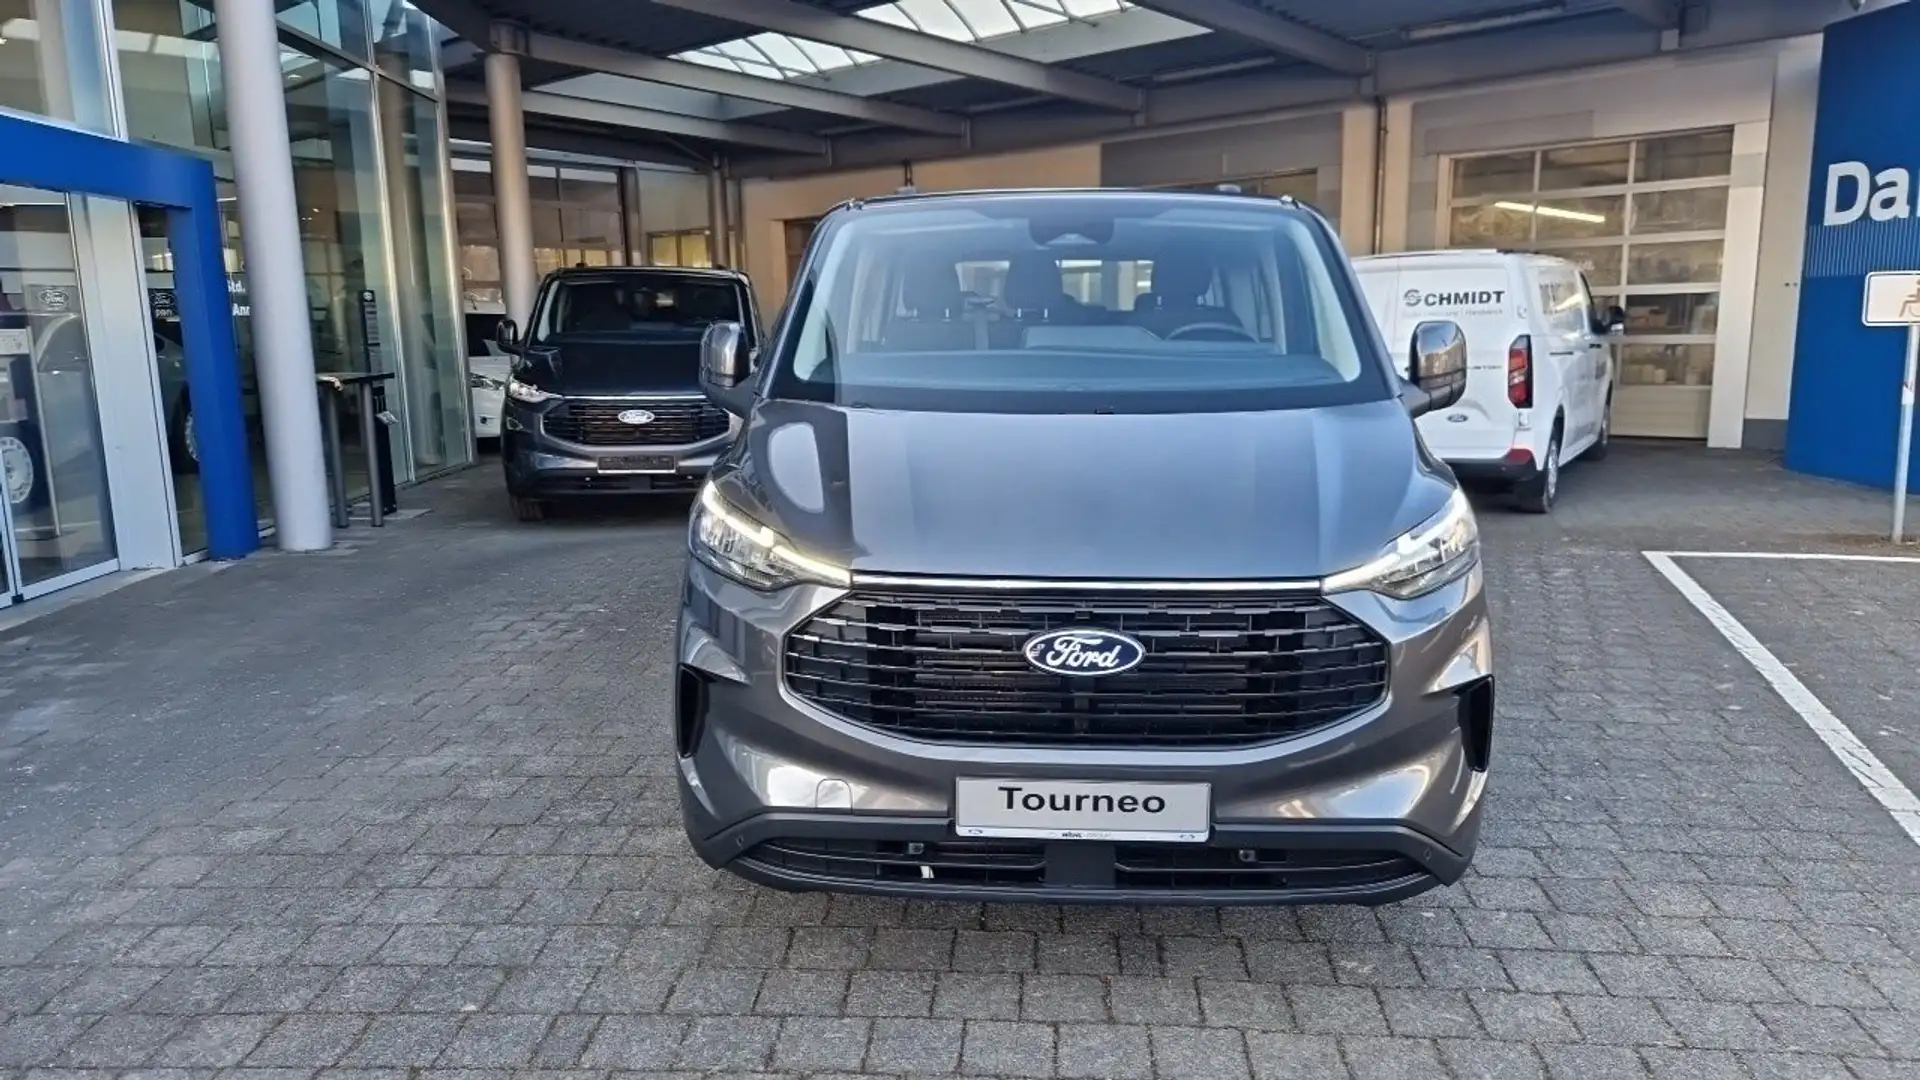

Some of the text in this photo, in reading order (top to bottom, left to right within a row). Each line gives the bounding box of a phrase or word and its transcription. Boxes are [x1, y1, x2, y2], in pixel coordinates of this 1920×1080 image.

[1823, 161, 1920, 226] Da
[1404, 288, 1505, 307] SCHMIDT
[1046, 636, 1122, 667] Ford
[997, 786, 1166, 814] Tourneo
